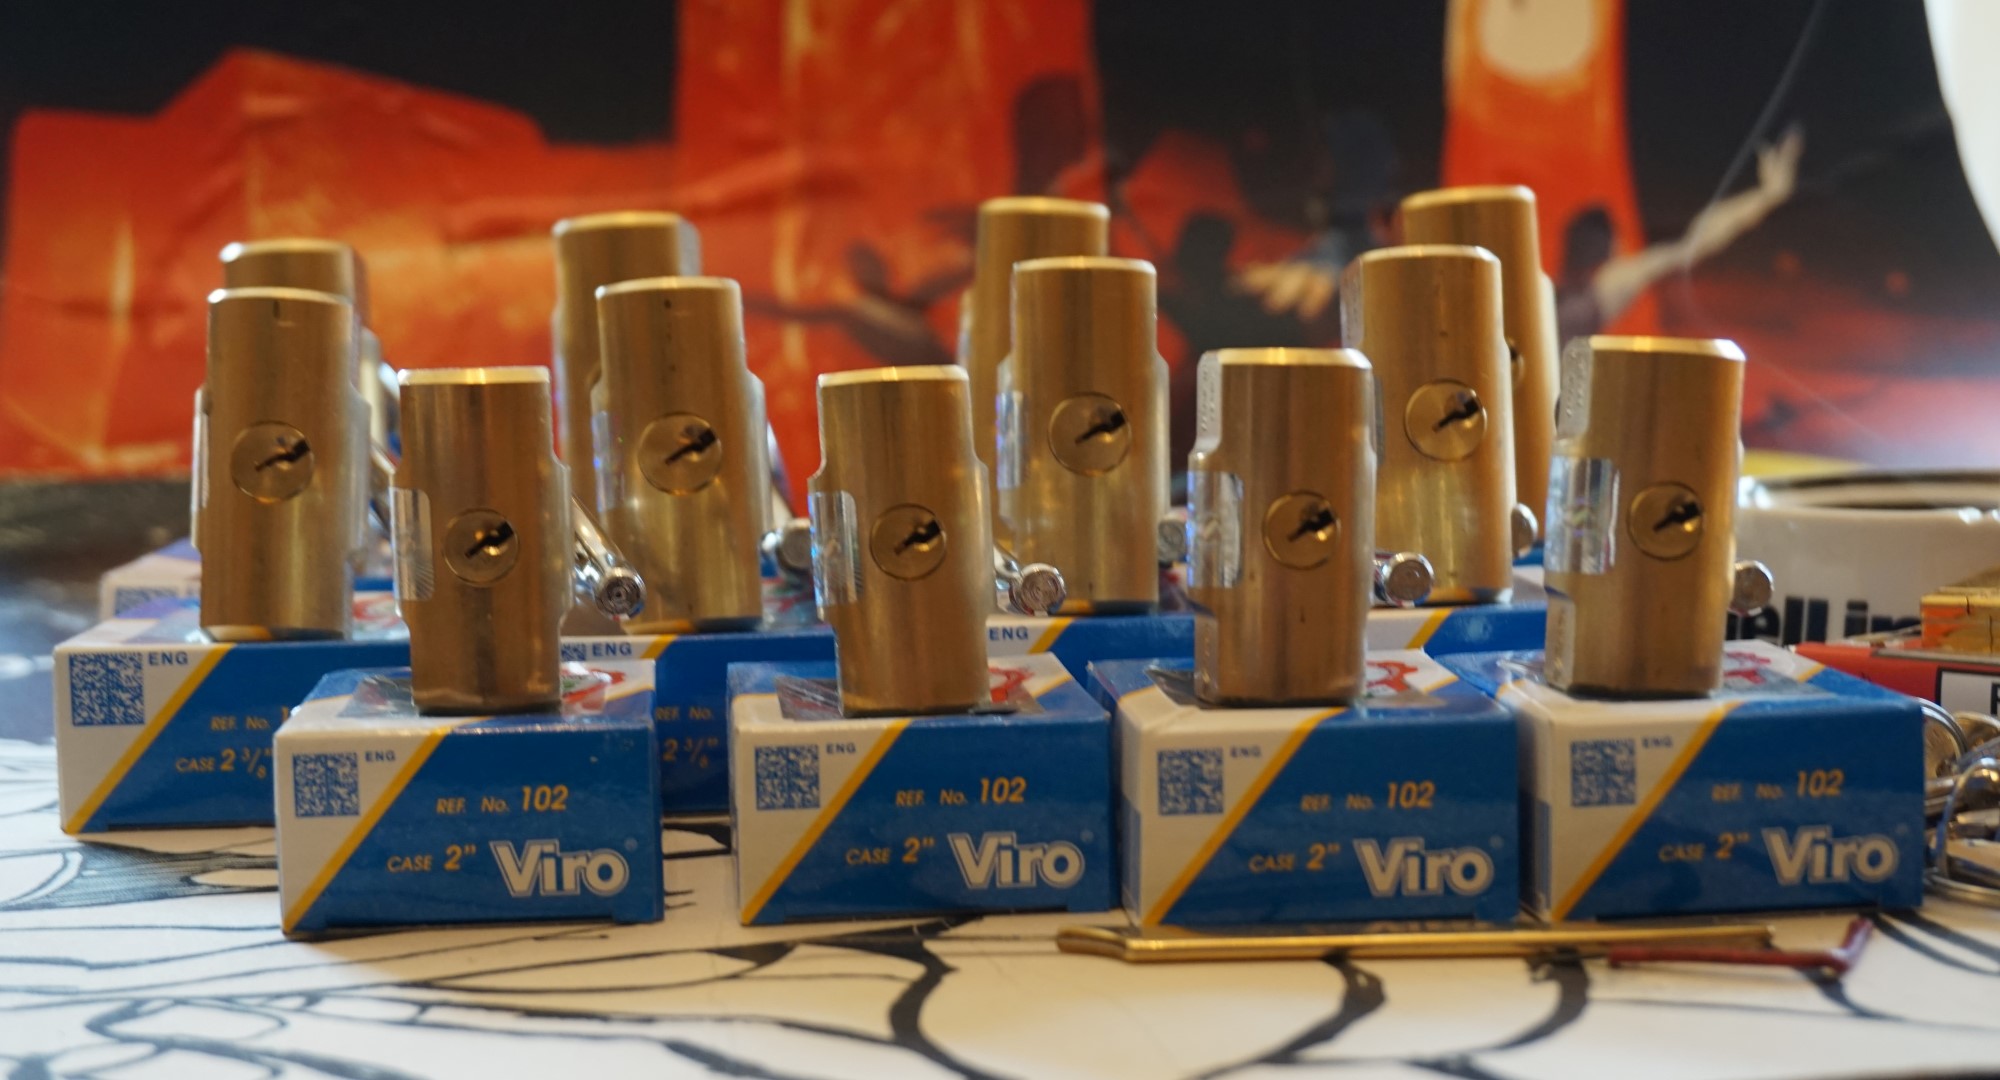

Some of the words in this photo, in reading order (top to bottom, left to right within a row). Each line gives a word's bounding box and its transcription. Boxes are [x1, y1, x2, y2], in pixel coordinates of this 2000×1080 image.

[1726, 597, 1828, 647] ell
[989, 626, 1028, 640] ENG
[148, 651, 188, 665] ENG
[591, 642, 632, 657] ENG
[826, 743, 857, 755] ENG
[1642, 736, 1672, 748] ENG
[365, 751, 396, 762] ENG
[1231, 746, 1262, 758] ENG
[175, 757, 215, 772] CASE
[939, 789, 968, 805] No.
[979, 776, 1027, 804] 102
[1796, 769, 1845, 797] 102
[480, 795, 510, 813] No.
[521, 784, 569, 811] 102
[1387, 780, 1437, 809] 102
[845, 847, 891, 865] CASE
[947, 831, 1085, 889] Viro
[1658, 843, 1705, 862] CASE
[1760, 825, 1899, 886] Viro
[386, 855, 433, 873] CASE
[488, 838, 630, 897] Viro
[1248, 853, 1295, 873] CASE
[1352, 837, 1494, 897] Viro
